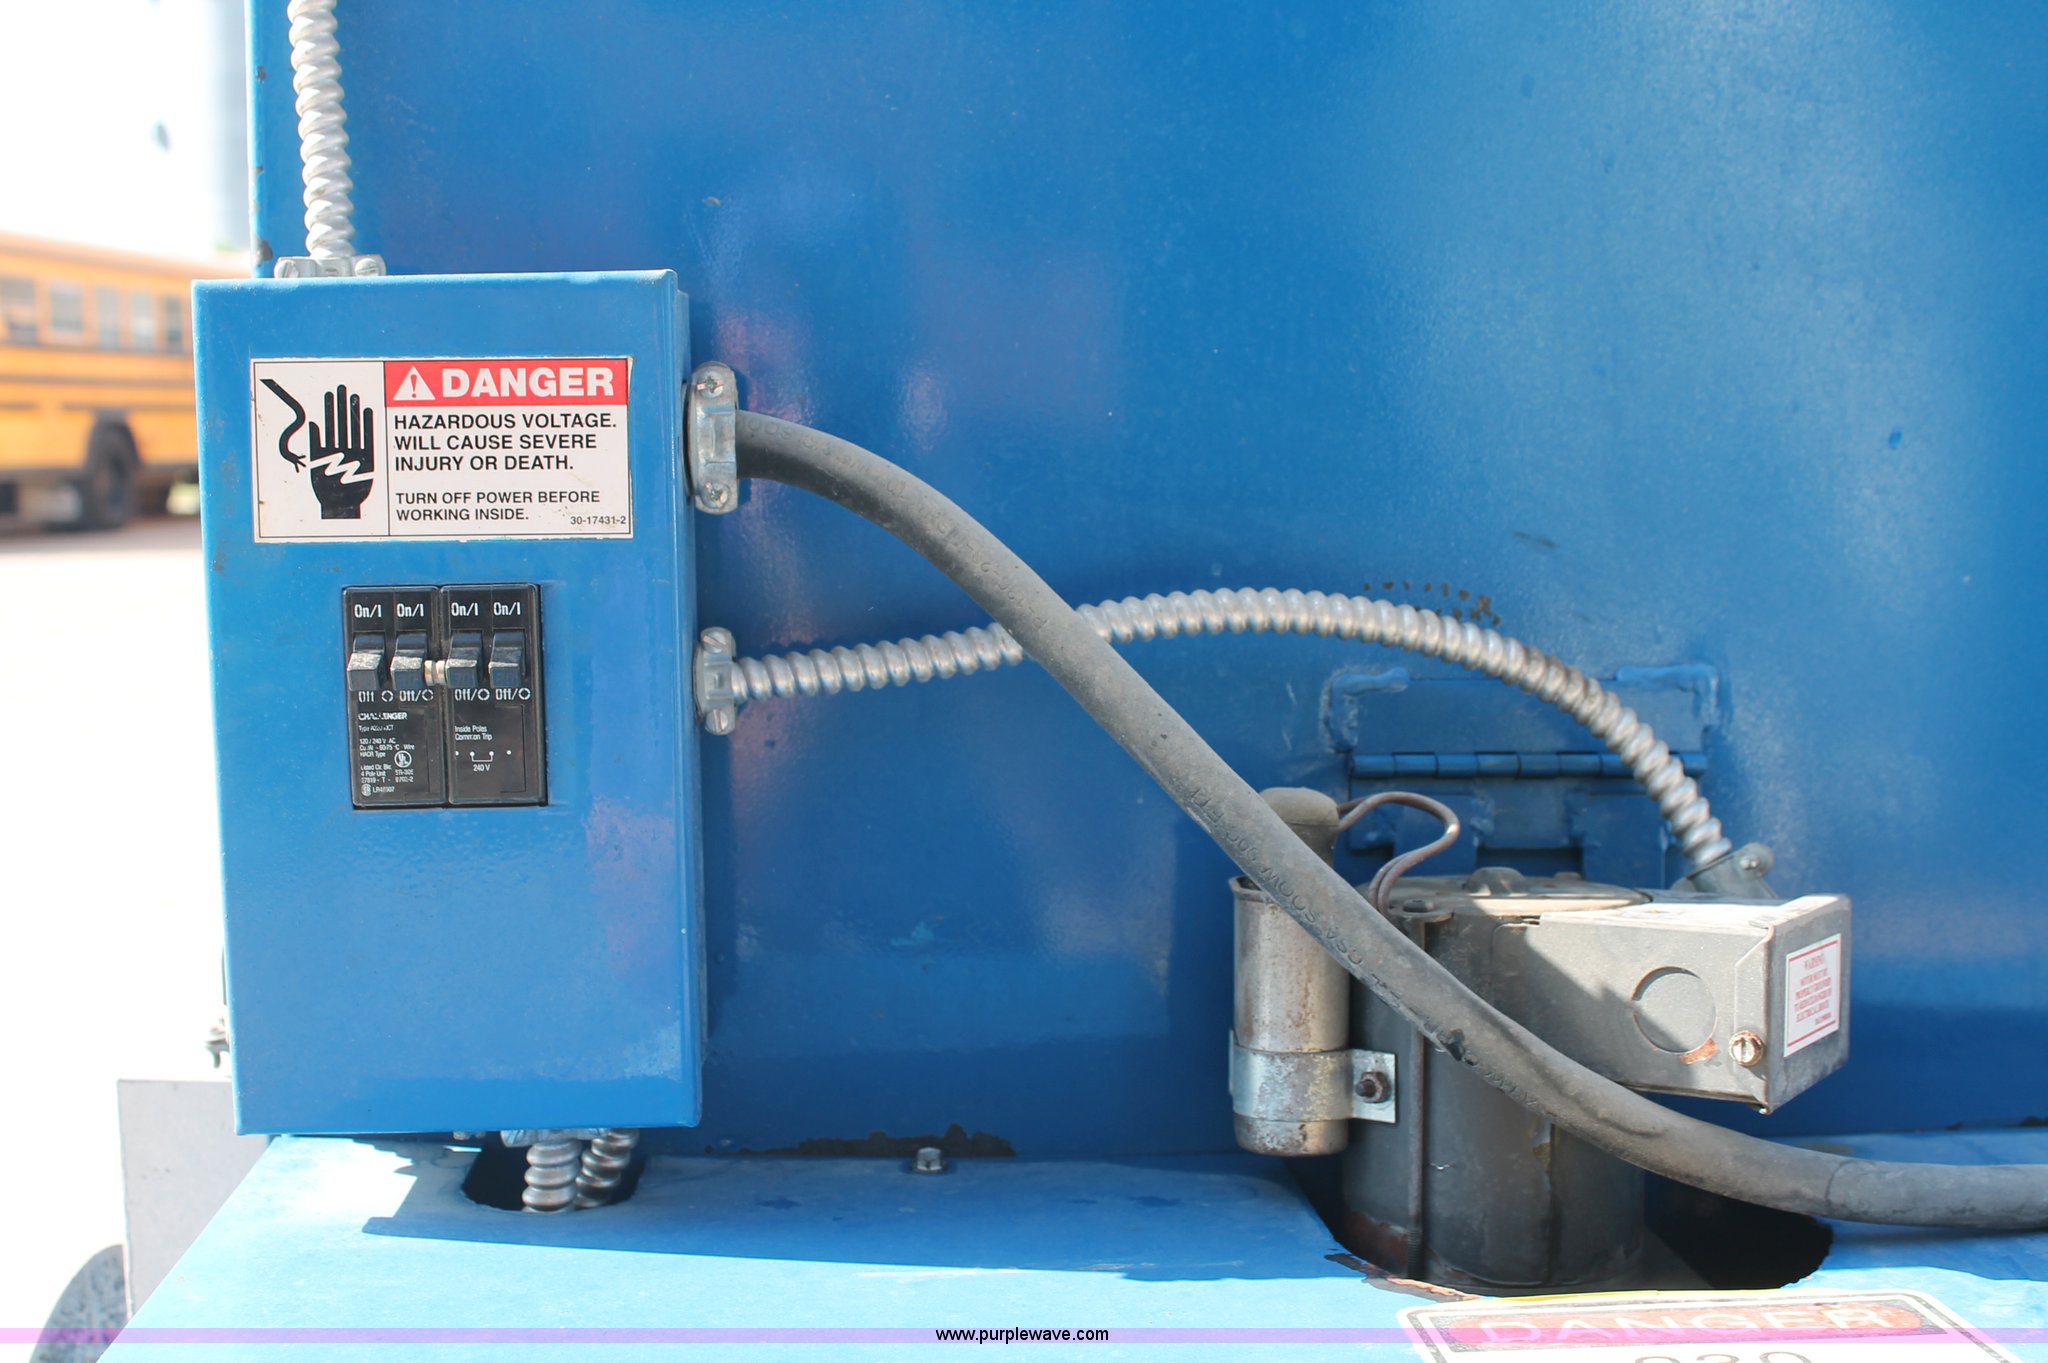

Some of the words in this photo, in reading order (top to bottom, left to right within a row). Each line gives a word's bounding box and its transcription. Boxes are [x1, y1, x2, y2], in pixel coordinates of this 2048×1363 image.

[442, 367, 613, 397] DANGER
[395, 414, 515, 429] HAZARDOUS
[523, 413, 616, 428] VOLTAGE.
[395, 435, 441, 450] WILL
[447, 435, 513, 450] CAUSE
[520, 434, 596, 449] SEVERE
[395, 456, 464, 471] INJURY
[471, 456, 497, 471] OR
[505, 455, 573, 470] DEATH.
[396, 493, 437, 505] TURN
[442, 492, 471, 504] OFF
[477, 492, 532, 504] POWER
[539, 491, 600, 503] BEFORE
[397, 509, 469, 521] WORKING
[475, 508, 528, 520] INSIDE.
[570, 516, 626, 525] 30-17431-2
[483, 733, 492, 741] Trip
[1478, 1308, 1893, 1343] DANGER
